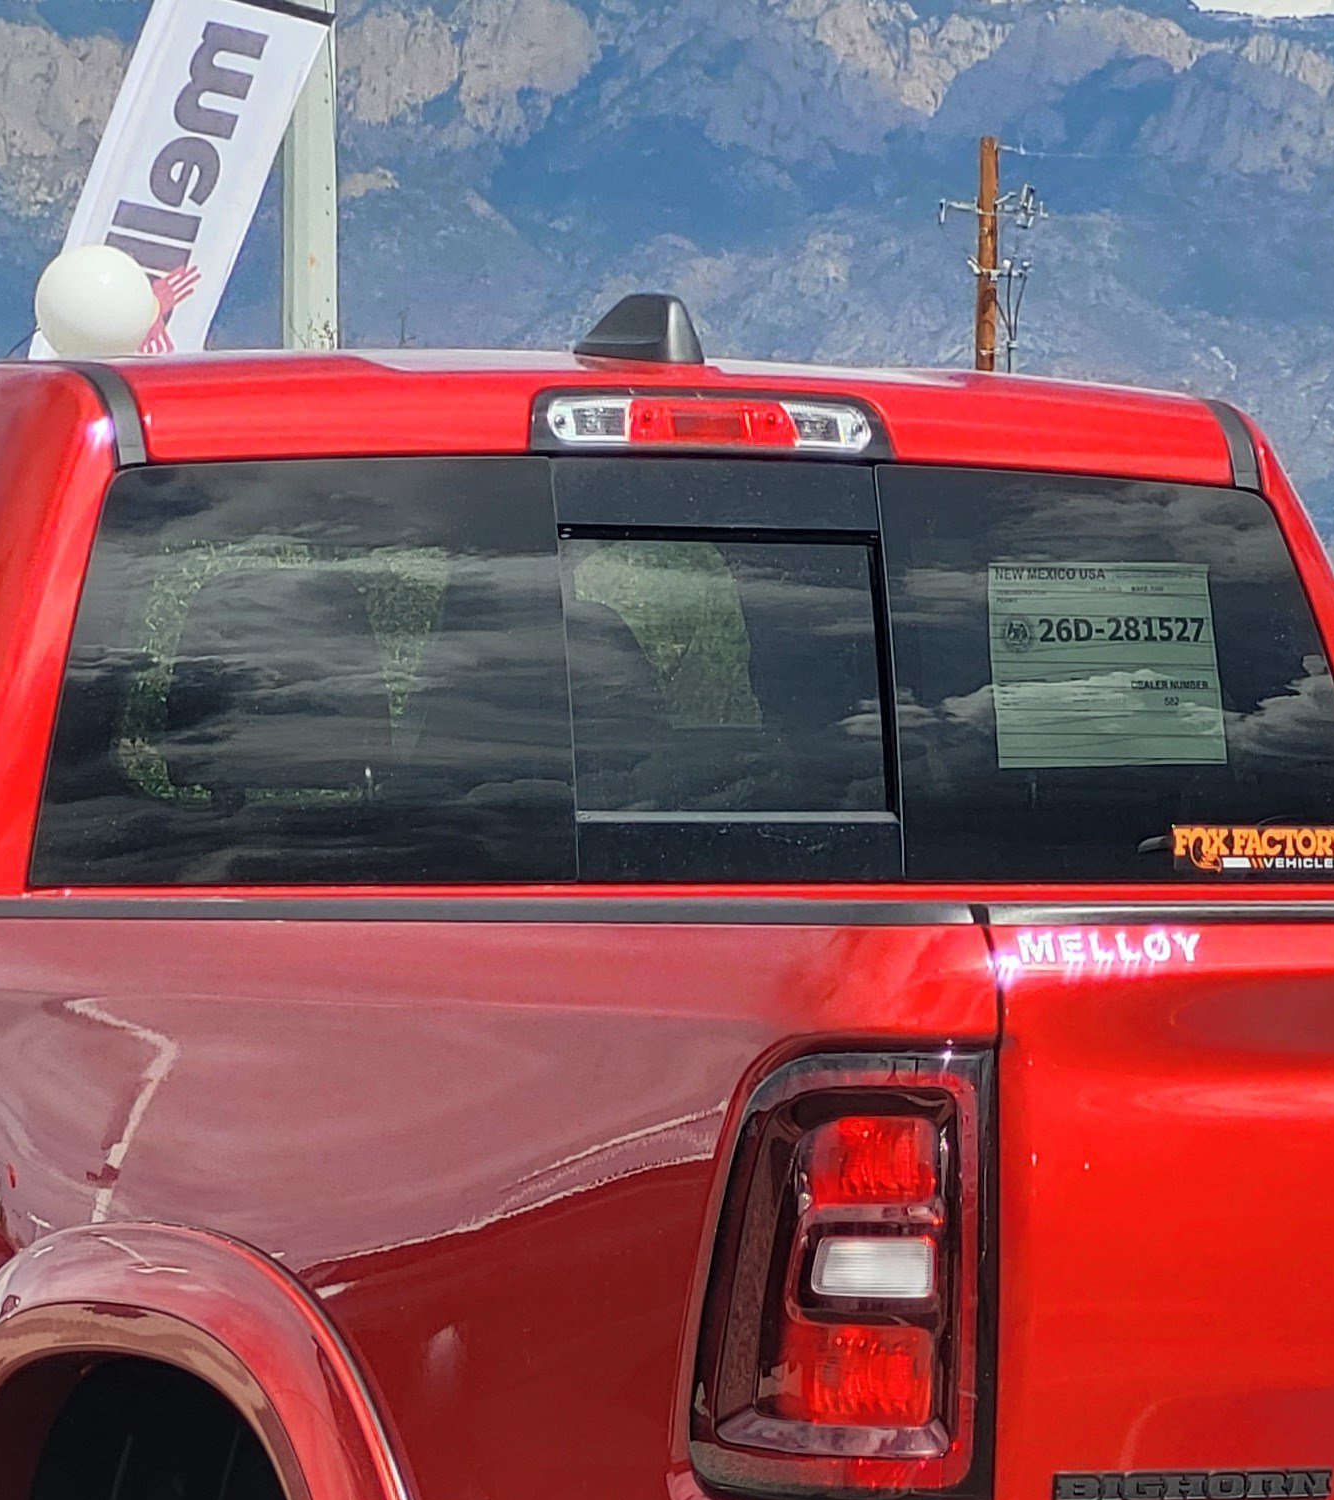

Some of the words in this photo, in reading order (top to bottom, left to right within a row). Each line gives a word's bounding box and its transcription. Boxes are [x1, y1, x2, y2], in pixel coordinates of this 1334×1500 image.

[995, 568, 1024, 580] NEW
[1027, 568, 1075, 580] MEXICO
[1079, 568, 1106, 580] USA
[1038, 616, 1205, 642] 26D-281527
[1131, 680, 1168, 690] DEALER
[1170, 680, 1209, 690] NUMBER
[1173, 827, 1229, 866] FOX
